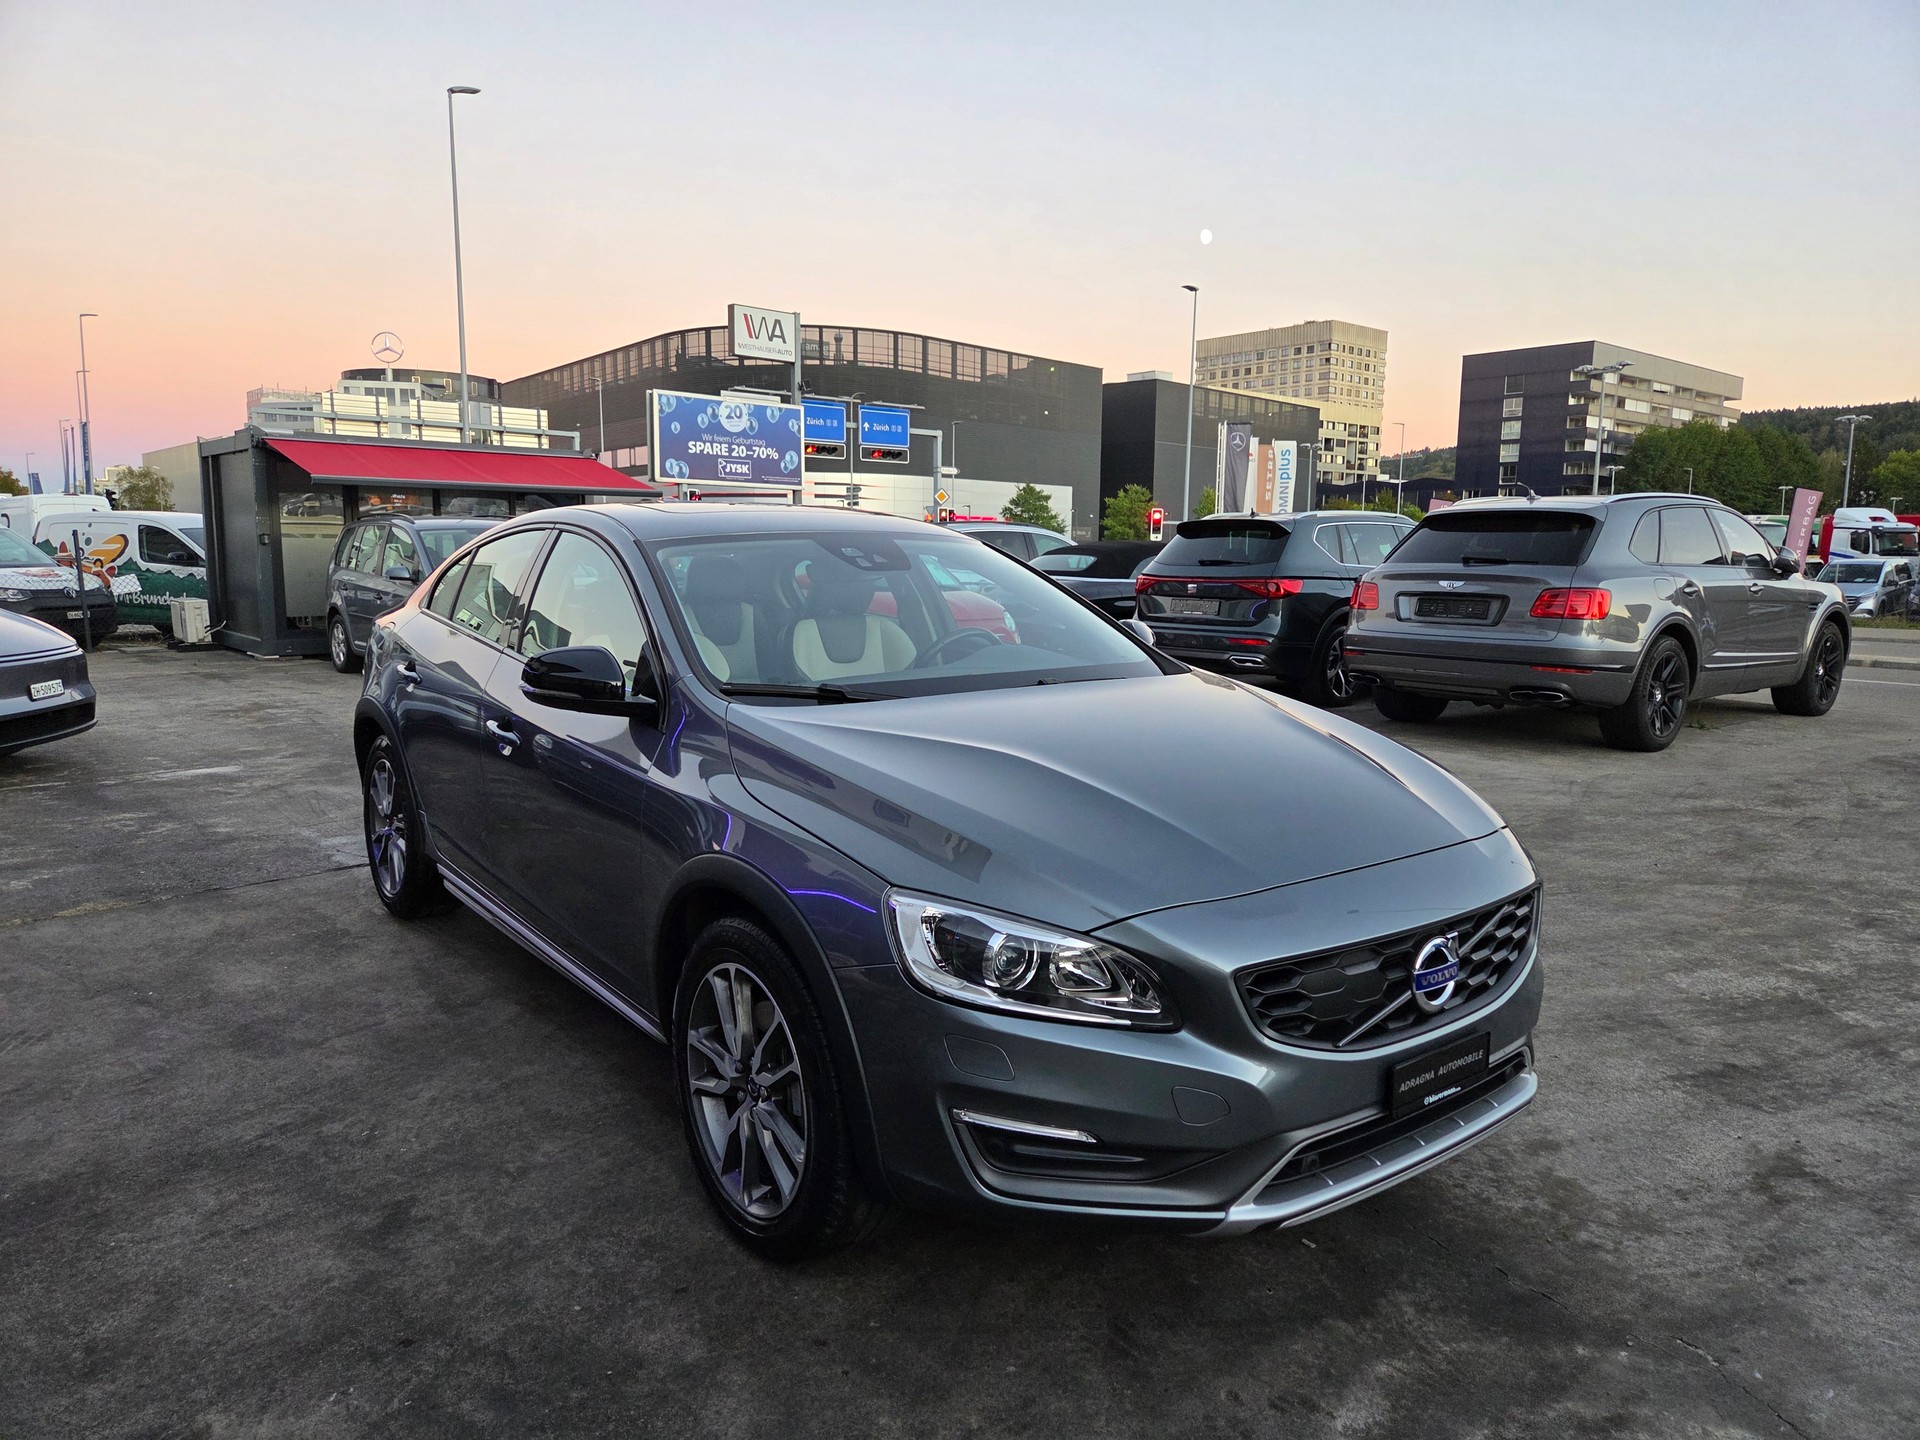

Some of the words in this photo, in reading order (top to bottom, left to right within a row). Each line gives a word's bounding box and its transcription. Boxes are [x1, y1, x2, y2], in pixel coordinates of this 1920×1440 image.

[725, 404, 743, 419] 20
[806, 417, 824, 426] Zürich
[872, 423, 889, 432] Zürich
[702, 433, 712, 441] Wir
[732, 435, 765, 447] Geburtstag
[688, 441, 728, 456] SPARE
[725, 463, 750, 474] JYSK
[1419, 966, 1457, 985] VOLVO
[1399, 1070, 1434, 1092] ADRAGNA
[1438, 1049, 1484, 1076] AUTOMOBILE
